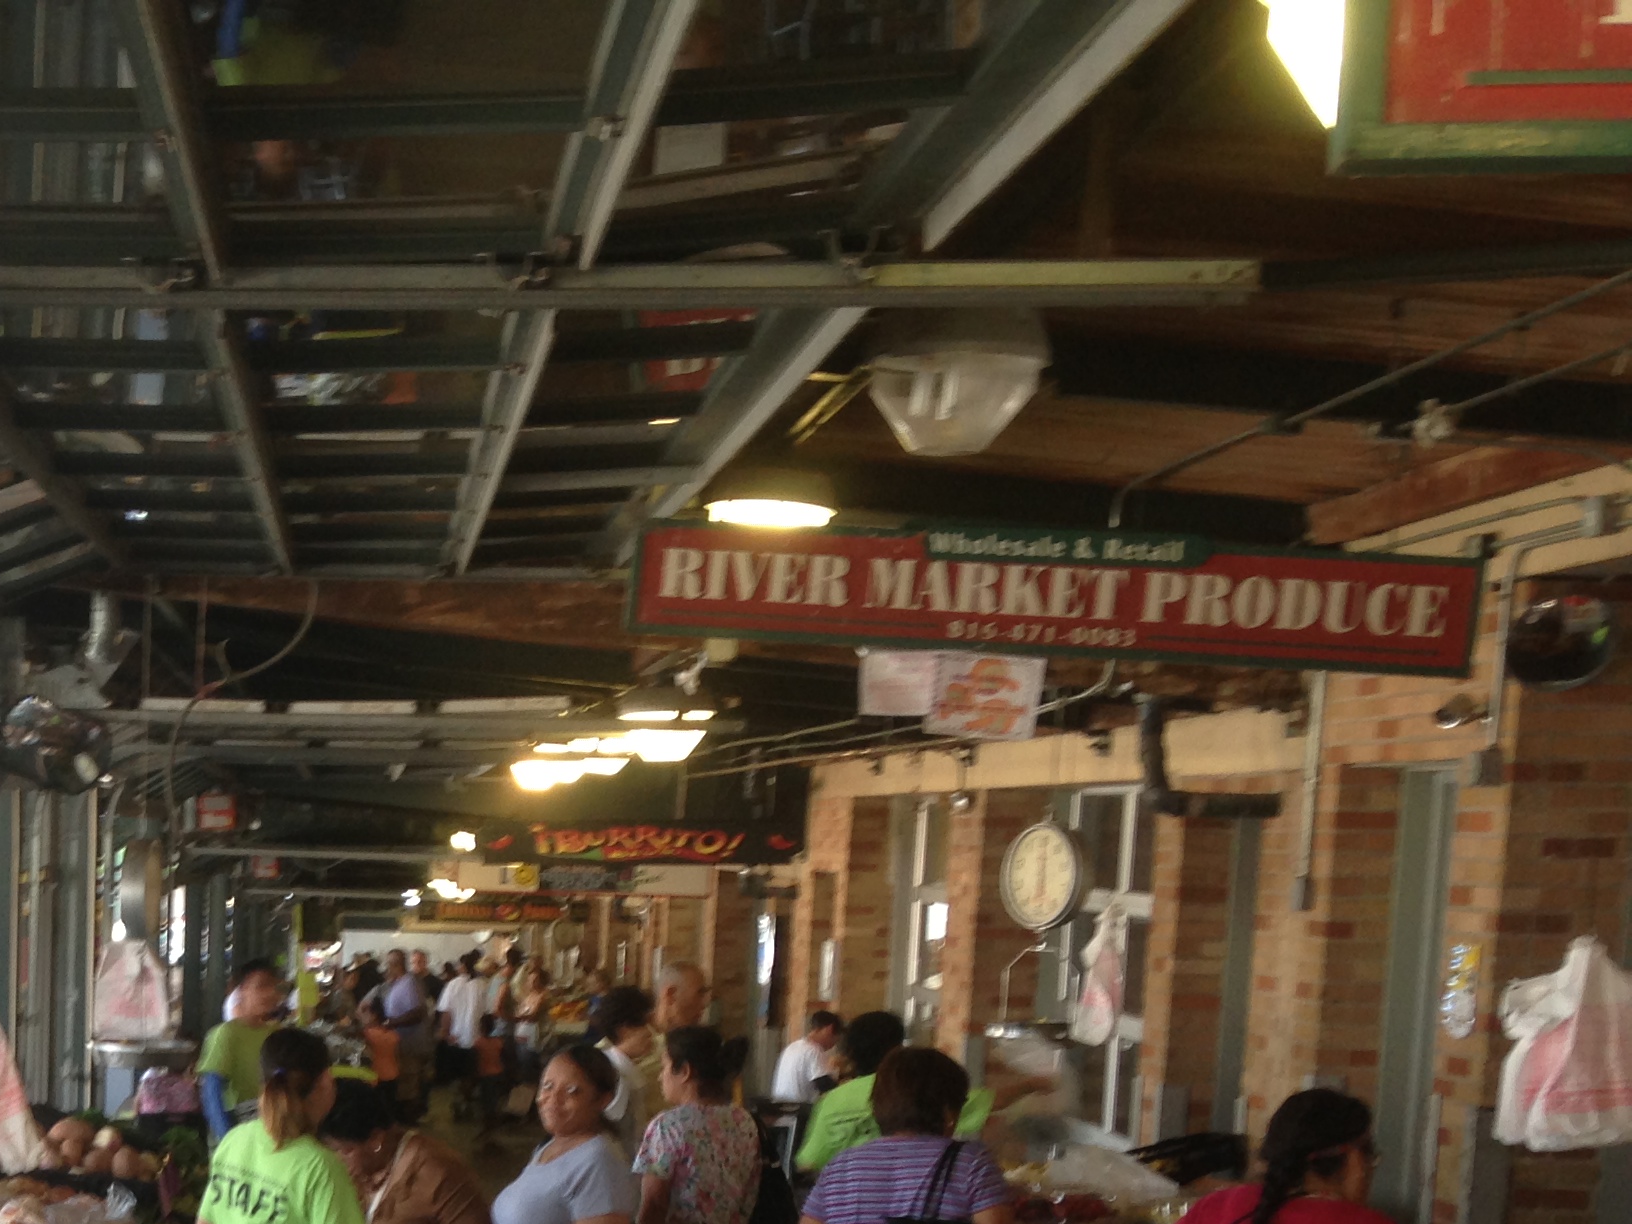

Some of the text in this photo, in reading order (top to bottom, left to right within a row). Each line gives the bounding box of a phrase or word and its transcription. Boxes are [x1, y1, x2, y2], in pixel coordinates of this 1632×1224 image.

[928, 532, 1186, 562] Wholesale & Retail
[659, 548, 1451, 638] RIVER MARKET PRODUCE
[211, 1173, 289, 1224] STAFF
